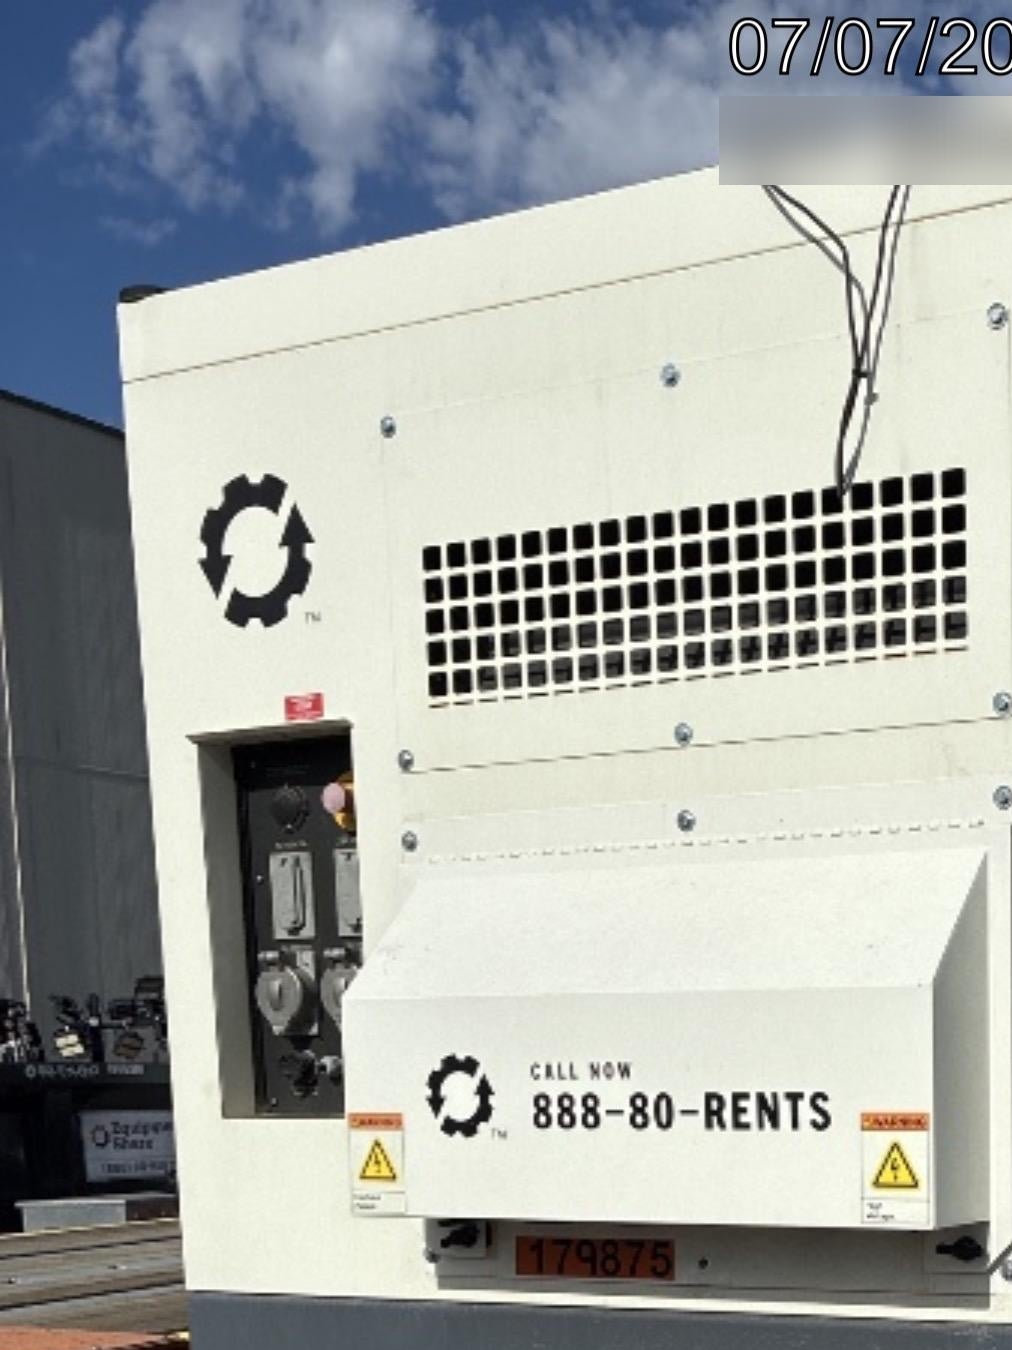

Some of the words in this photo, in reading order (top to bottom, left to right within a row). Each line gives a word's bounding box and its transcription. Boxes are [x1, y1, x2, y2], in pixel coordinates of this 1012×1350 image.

[530, 1060, 579, 1081] CALL
[590, 1060, 632, 1081] NOW
[533, 1091, 832, 1132] 888-80-RENTS
[529, 1238, 673, 1278] 179875
